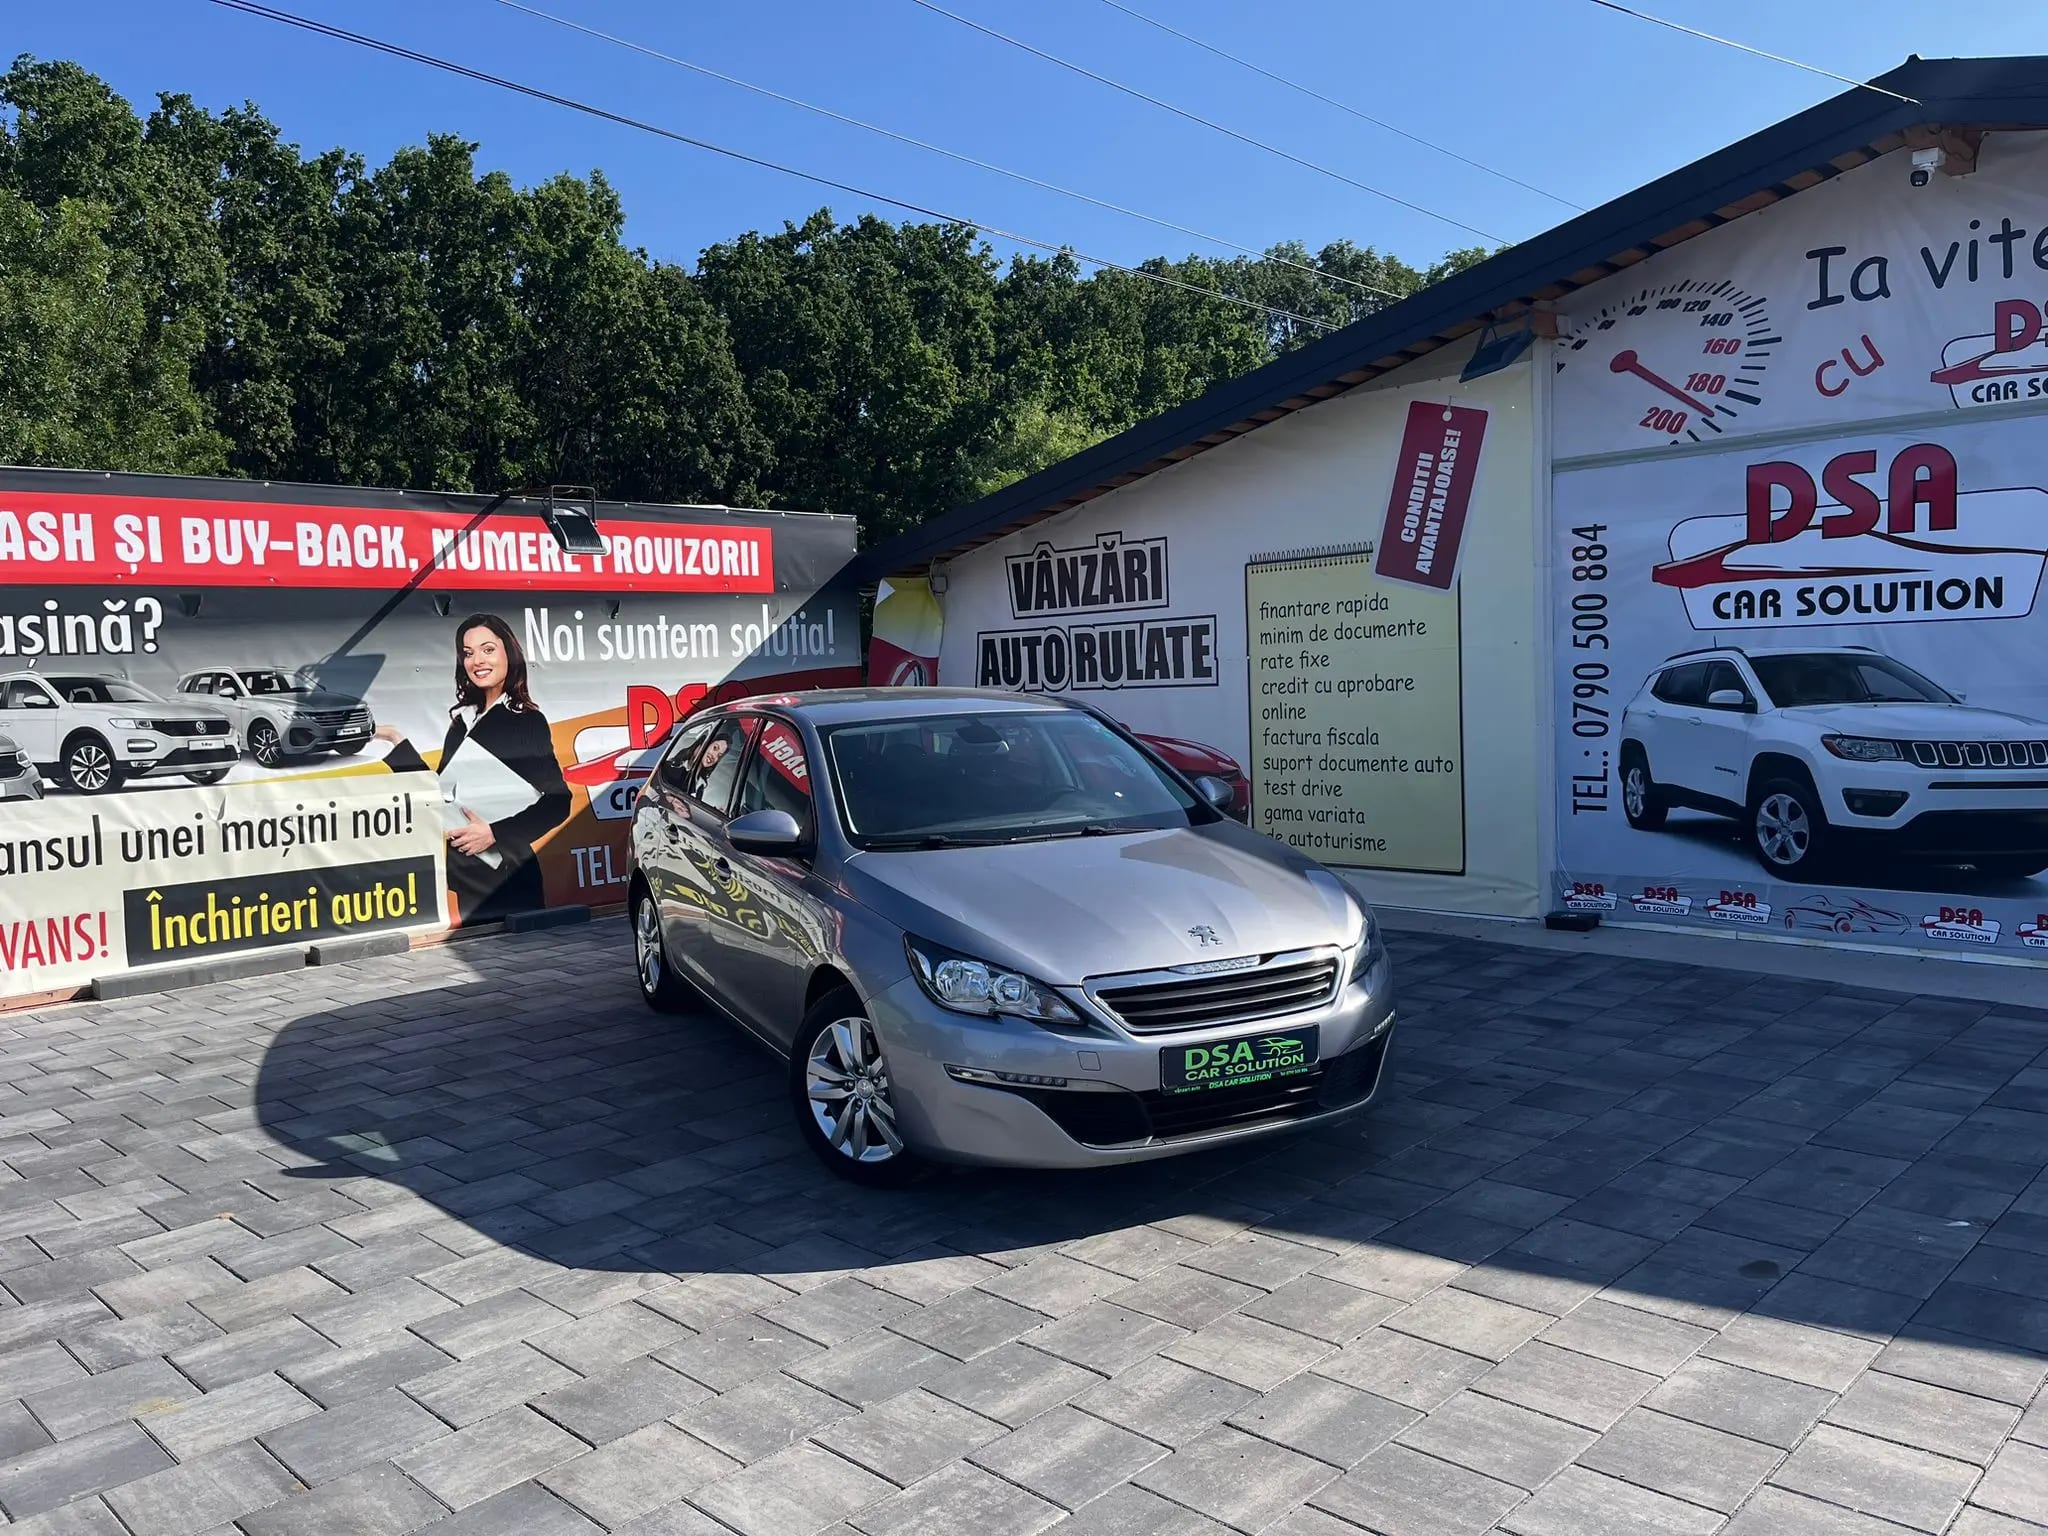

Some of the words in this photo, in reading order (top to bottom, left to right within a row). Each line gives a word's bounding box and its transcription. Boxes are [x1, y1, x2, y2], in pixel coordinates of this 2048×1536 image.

[1805, 246, 1891, 310] Ia
[1682, 299, 1711, 312] 120
[1700, 313, 1733, 327] 140
[1995, 298, 2048, 353] D
[1702, 338, 1741, 355] 160
[1815, 334, 1885, 397] cu
[1684, 372, 1726, 394] 180
[1971, 381, 2018, 403] CAR
[1639, 406, 1687, 434] 200
[1400, 452, 1434, 544] CONDITII
[1416, 429, 1462, 575] AVANTAJOASE!
[1746, 443, 1957, 544] DSA
[181, 517, 420, 572] BUY-BACK,
[1572, 524, 1608, 581] 884
[1011, 540, 1163, 612] VÂNZĂRI
[1259, 600, 1331, 621] finantare
[1336, 592, 1389, 618] rapida
[1712, 588, 1782, 620] CAR
[1797, 576, 2004, 617] SOLUTION
[1260, 628, 1304, 645] minim
[1309, 624, 1329, 642] de
[1334, 619, 1427, 640] documente
[1572, 594, 1609, 650] 500
[524, 607, 585, 662] Noi
[599, 615, 720, 661] suntem
[1261, 653, 1294, 670] rate
[1300, 650, 1330, 669] fixe
[1262, 676, 1309, 695] credit
[1314, 682, 1332, 694] cu
[1337, 674, 1415, 698] aprobare
[1262, 702, 1307, 720] online
[1572, 663, 1609, 738] 0790
[1263, 727, 1321, 746] factura
[1327, 727, 1380, 747] fiscala
[1263, 756, 1312, 775] suport
[1319, 753, 1409, 772] documente
[1415, 756, 1454, 773] auto
[1264, 780, 1296, 796] test
[1301, 779, 1343, 797] drive
[120, 813, 205, 862] unei
[221, 802, 339, 857] mașini
[352, 793, 413, 840] noi!
[1264, 807, 1303, 825] gama
[1308, 806, 1366, 824] variata
[1288, 833, 1387, 852] autoturisme
[1572, 882, 1605, 897] DSA
[1644, 886, 1678, 901] DSA
[1720, 890, 1756, 908] DSA
[145, 886, 319, 951] Închirieri
[332, 873, 418, 923] auto!
[1653, 906, 1685, 914] SOLUTION
[1729, 913, 1764, 921] SOLUTION
[1939, 906, 1983, 926] DSA
[1950, 931, 1991, 942] SOLUTION
[1185, 1041, 1254, 1070] DSA
[1185, 1067, 1220, 1081] CAR
[1225, 1053, 1304, 1075] SOLUTION
[1209, 1080, 1224, 1089] DSA
[1224, 1078, 1239, 1087] CAR
[1239, 1073, 1271, 1085] SOLUTION
